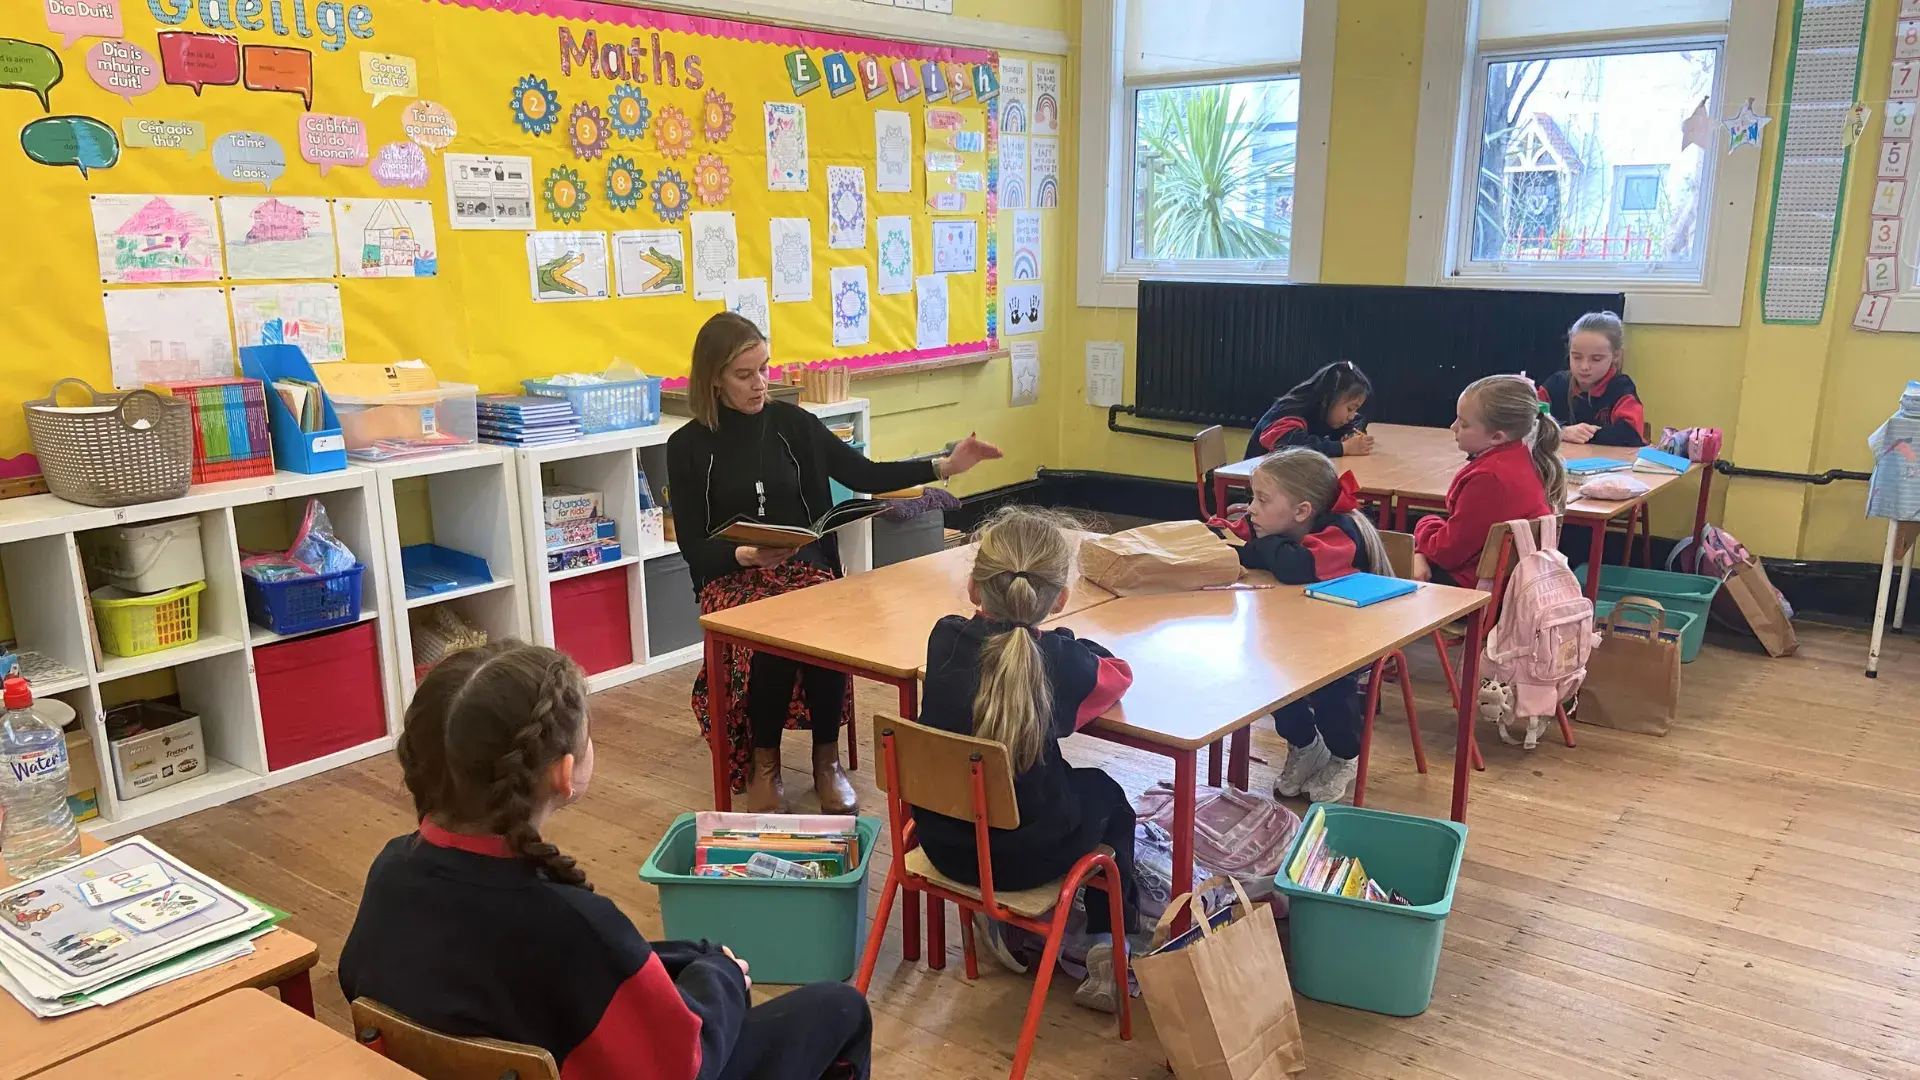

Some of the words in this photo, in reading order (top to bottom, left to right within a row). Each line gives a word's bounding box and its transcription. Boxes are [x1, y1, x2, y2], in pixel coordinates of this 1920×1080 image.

[50, 0, 75, 16] Dia
[78, 2, 114, 19] Duit!
[1905, 27, 1917, 46] 8
[102, 41, 127, 58] Dia
[130, 46, 142, 60] is
[559, 26, 704, 90] Maths
[97, 58, 151, 76] mhuire
[370, 58, 407, 75] Conas
[795, 53, 991, 93] English
[108, 74, 142, 89] duit!
[370, 74, 390, 86] atá
[392, 75, 410, 88] tú?
[1900, 68, 1912, 86] 7
[530, 97, 539, 112] 2
[626, 105, 633, 118] 4
[412, 108, 426, 122] Tá
[427, 112, 446, 124] mé
[711, 110, 717, 122] 6
[1893, 107, 1907, 126] 6
[138, 119, 165, 135] Cén
[166, 121, 193, 136] aois
[306, 118, 324, 131] Cá
[325, 118, 360, 135] bhfuil
[406, 125, 422, 137] go
[583, 125, 590, 138] 3
[670, 127, 677, 139] 5
[152, 135, 181, 148] thú?
[229, 134, 245, 147] Tá
[247, 136, 266, 148] mé
[308, 132, 320, 145] tú
[328, 133, 344, 146] do
[1887, 147, 1901, 165] 5
[232, 165, 270, 179] d'aois.
[704, 172, 718, 185] 10
[617, 176, 625, 190] 8
[561, 188, 569, 202] 7
[667, 189, 674, 202] 9
[1882, 186, 1895, 204] 4
[1878, 225, 1891, 242] 3
[1876, 262, 1888, 280] 2
[1867, 300, 1876, 317] 1
[552, 497, 591, 510] Charades
[558, 509, 568, 517] for
[569, 507, 585, 516] Kids
[165, 744, 194, 758] Trident
[10, 754, 59, 781] Water
[109, 872, 152, 892] abc
